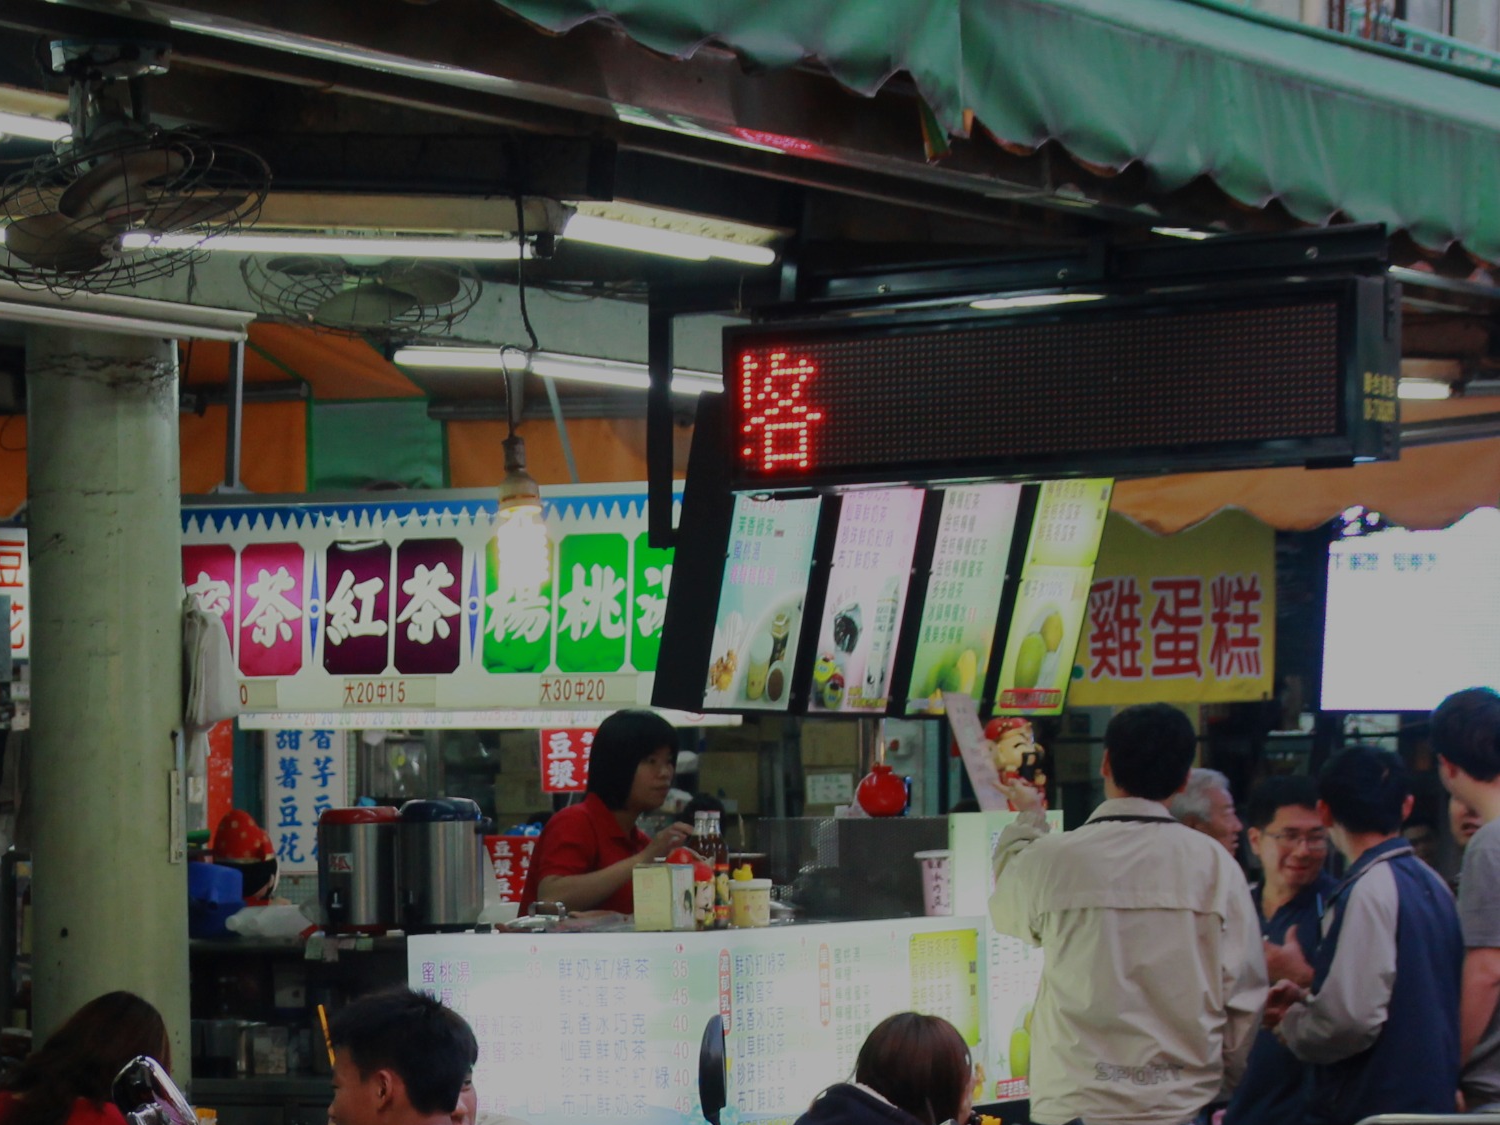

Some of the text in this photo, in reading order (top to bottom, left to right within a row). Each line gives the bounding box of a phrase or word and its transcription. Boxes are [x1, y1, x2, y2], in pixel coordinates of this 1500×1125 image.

[326, 562, 461, 645] 紅茶
[1087, 574, 1263, 681] 雞蛋糕
[547, 732, 579, 788] 豆漿
[421, 961, 470, 984] 蜜桃湯
[526, 962, 541, 981] 35
[672, 959, 687, 978] 35
[672, 987, 688, 1005] 45
[672, 1014, 688, 1032] 40
[560, 1040, 647, 1062] 仙草鮮奶茶
[673, 1041, 689, 1059] 40
[674, 1069, 689, 1086] 40
[1095, 1062, 1182, 1086] SPORT
[562, 1094, 648, 1116] 布丁鮮奶茶
[674, 1095, 690, 1114] 45
